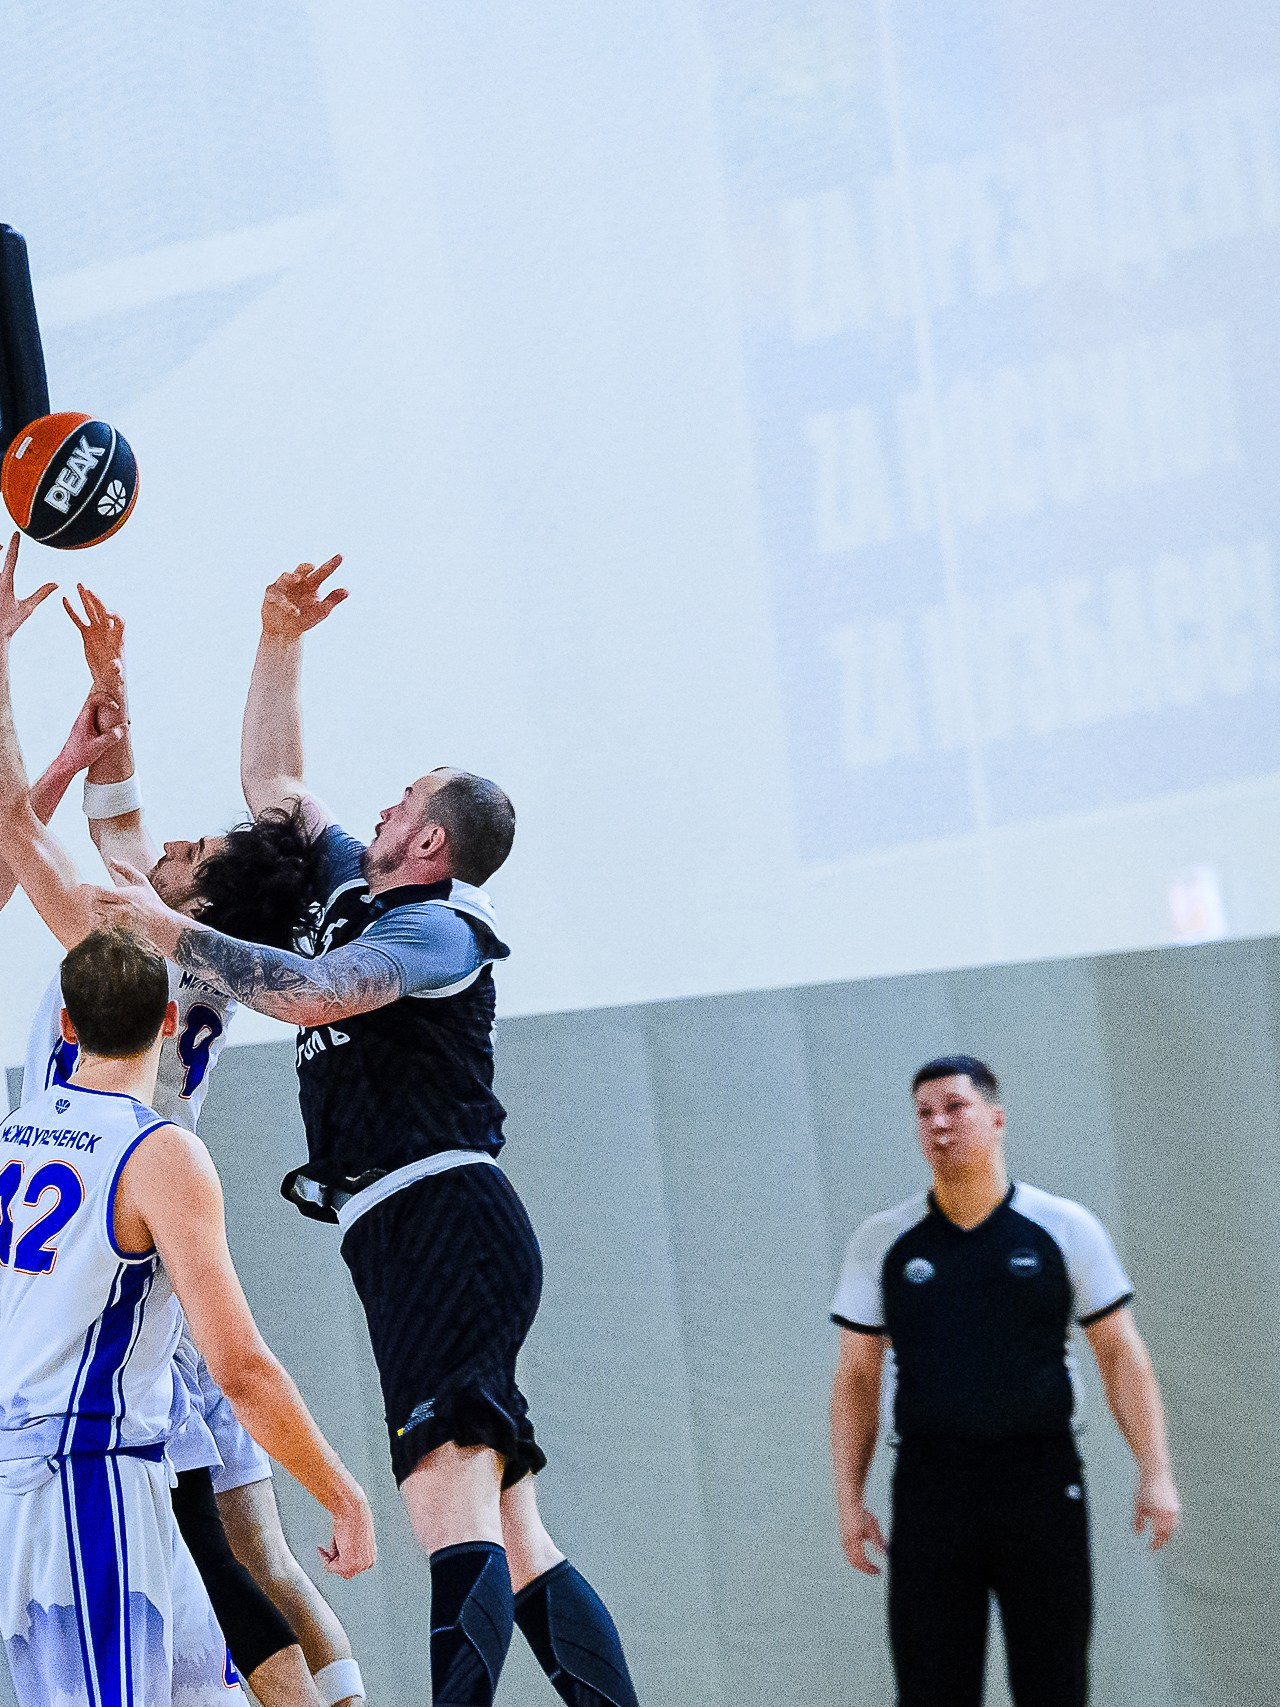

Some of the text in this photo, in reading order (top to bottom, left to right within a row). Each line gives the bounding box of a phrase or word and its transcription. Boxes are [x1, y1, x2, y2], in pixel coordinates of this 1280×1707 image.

[44, 435, 106, 514] PEAK
[177, 1002, 223, 1099] 9
[297, 1026, 351, 1067] ГОЛЬ
